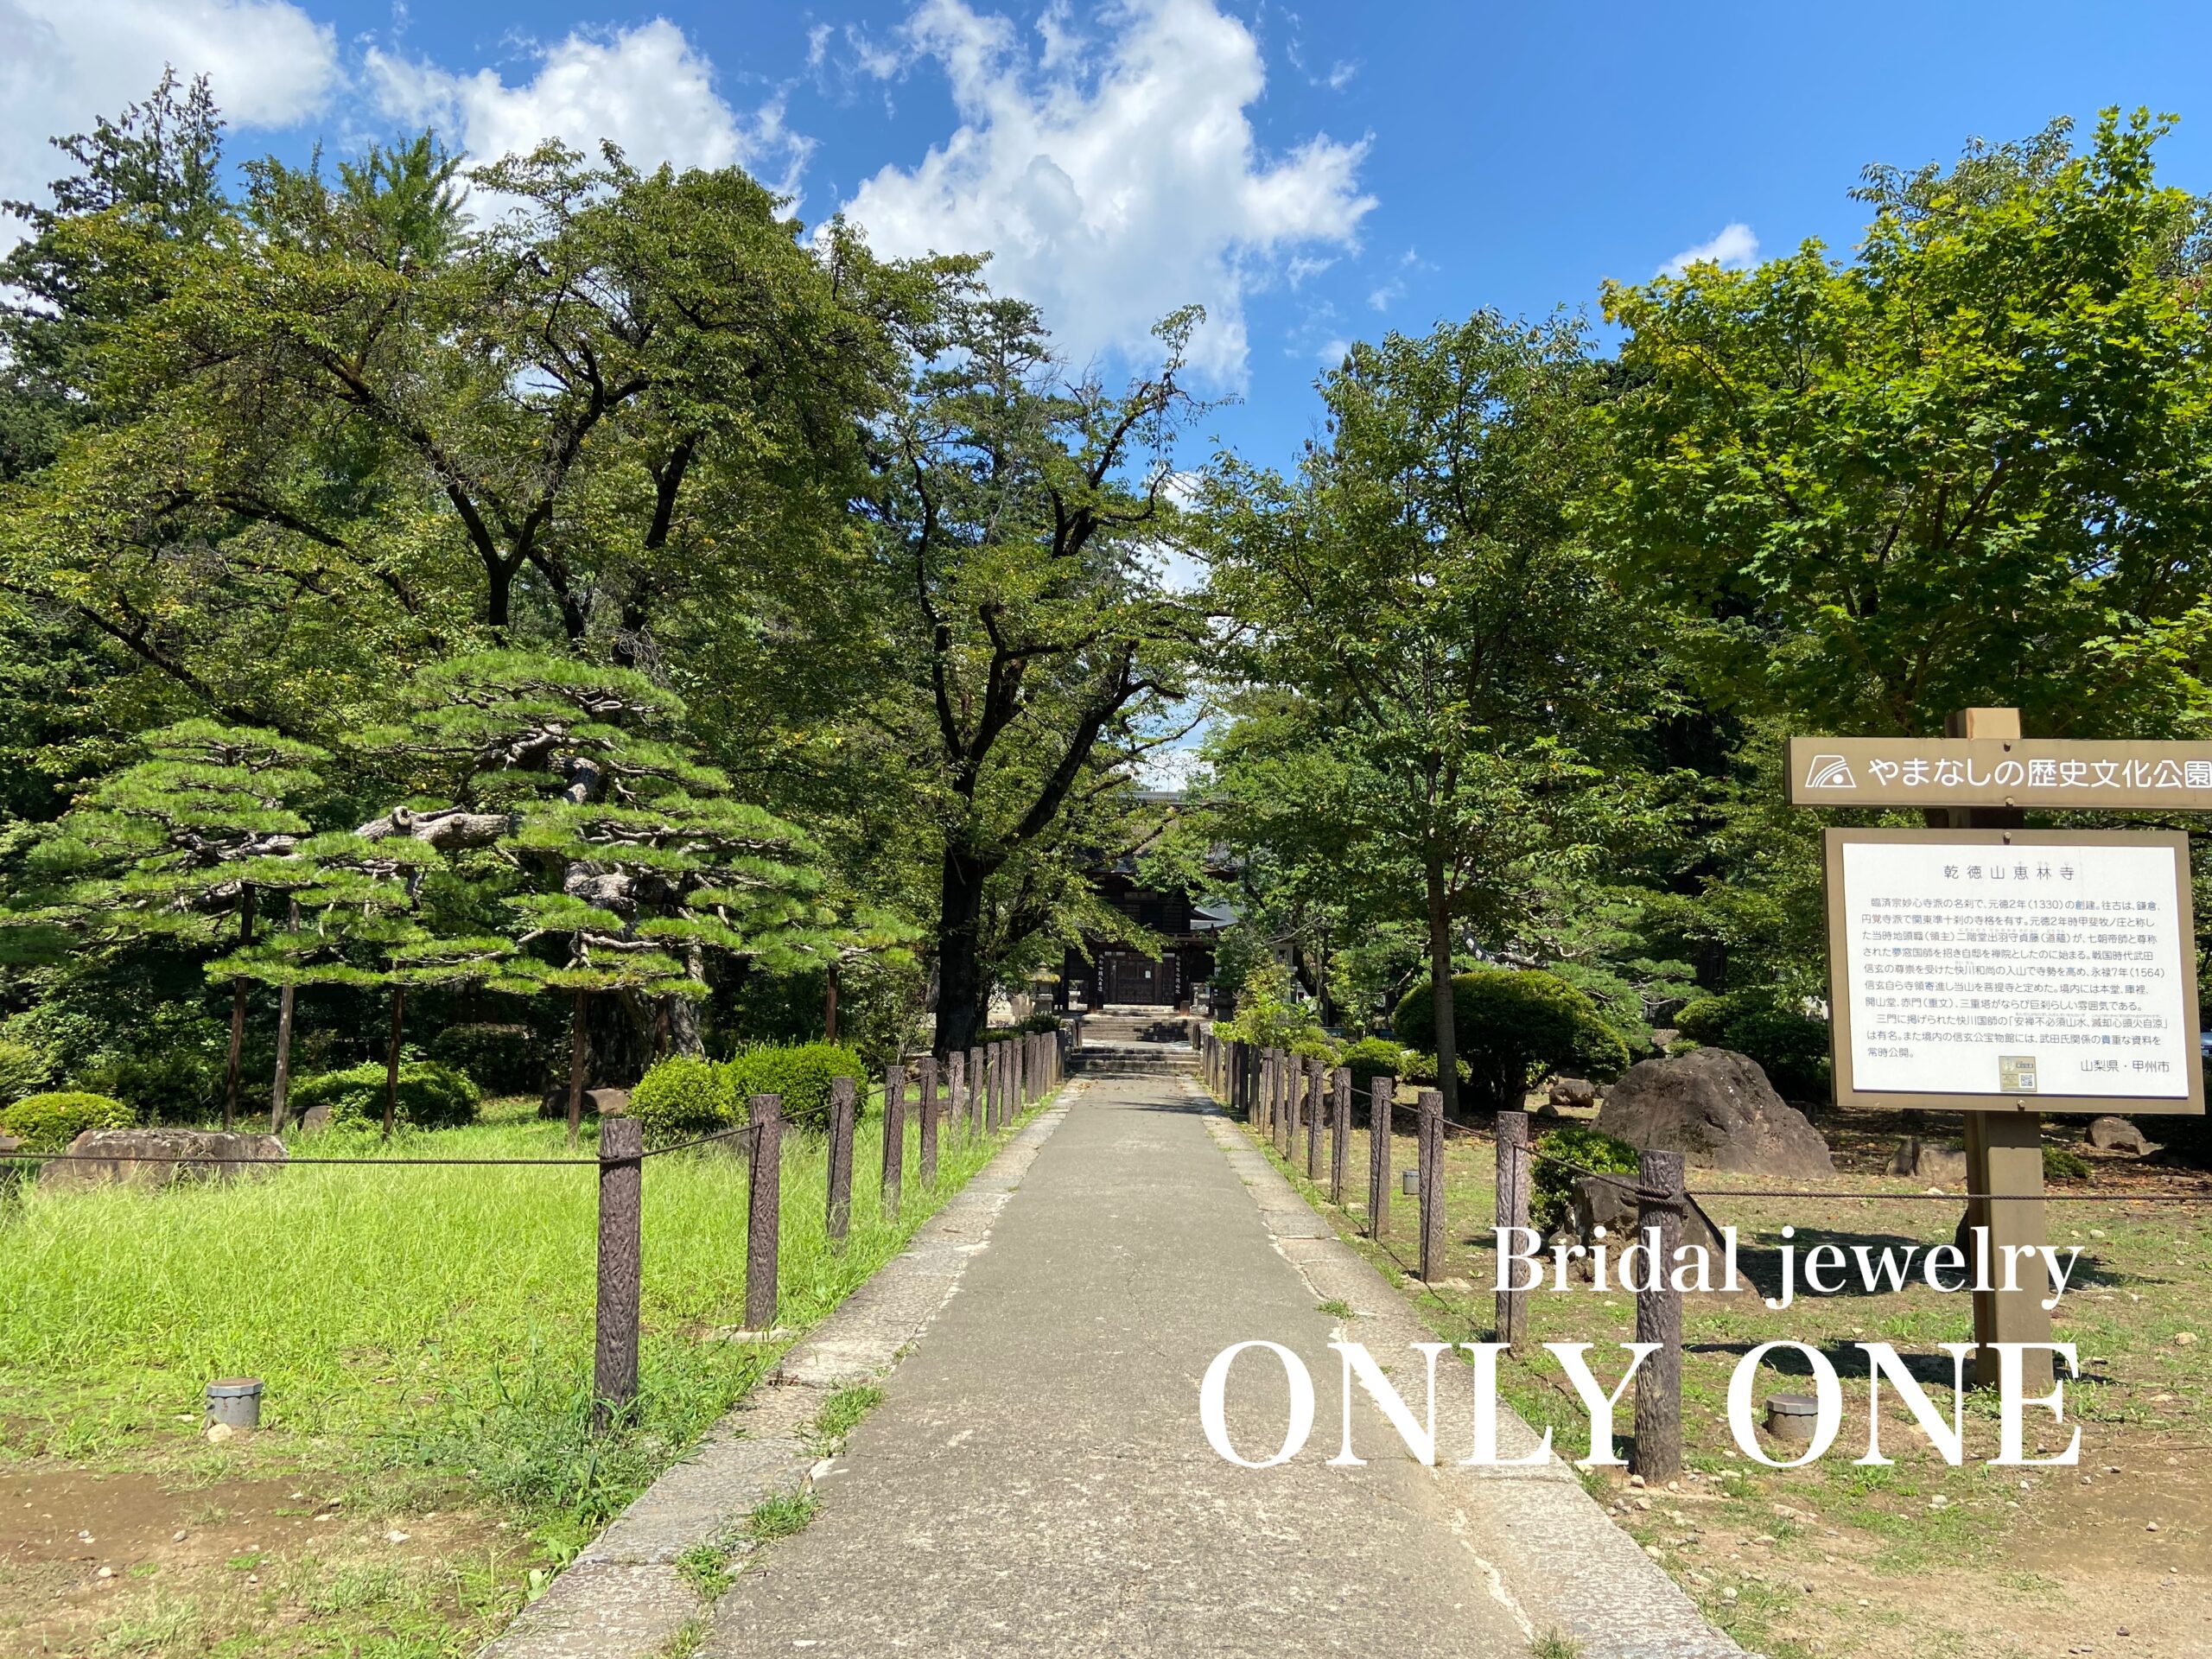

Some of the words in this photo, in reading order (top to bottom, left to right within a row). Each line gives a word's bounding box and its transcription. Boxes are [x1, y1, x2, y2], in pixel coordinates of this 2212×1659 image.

[1868, 757, 2212, 790] やまなしの歴史文化公園
[1943, 864, 2075, 880] 乾徳山恵林寺
[2081, 1059, 2170, 1073] 山梨県・甲州市
